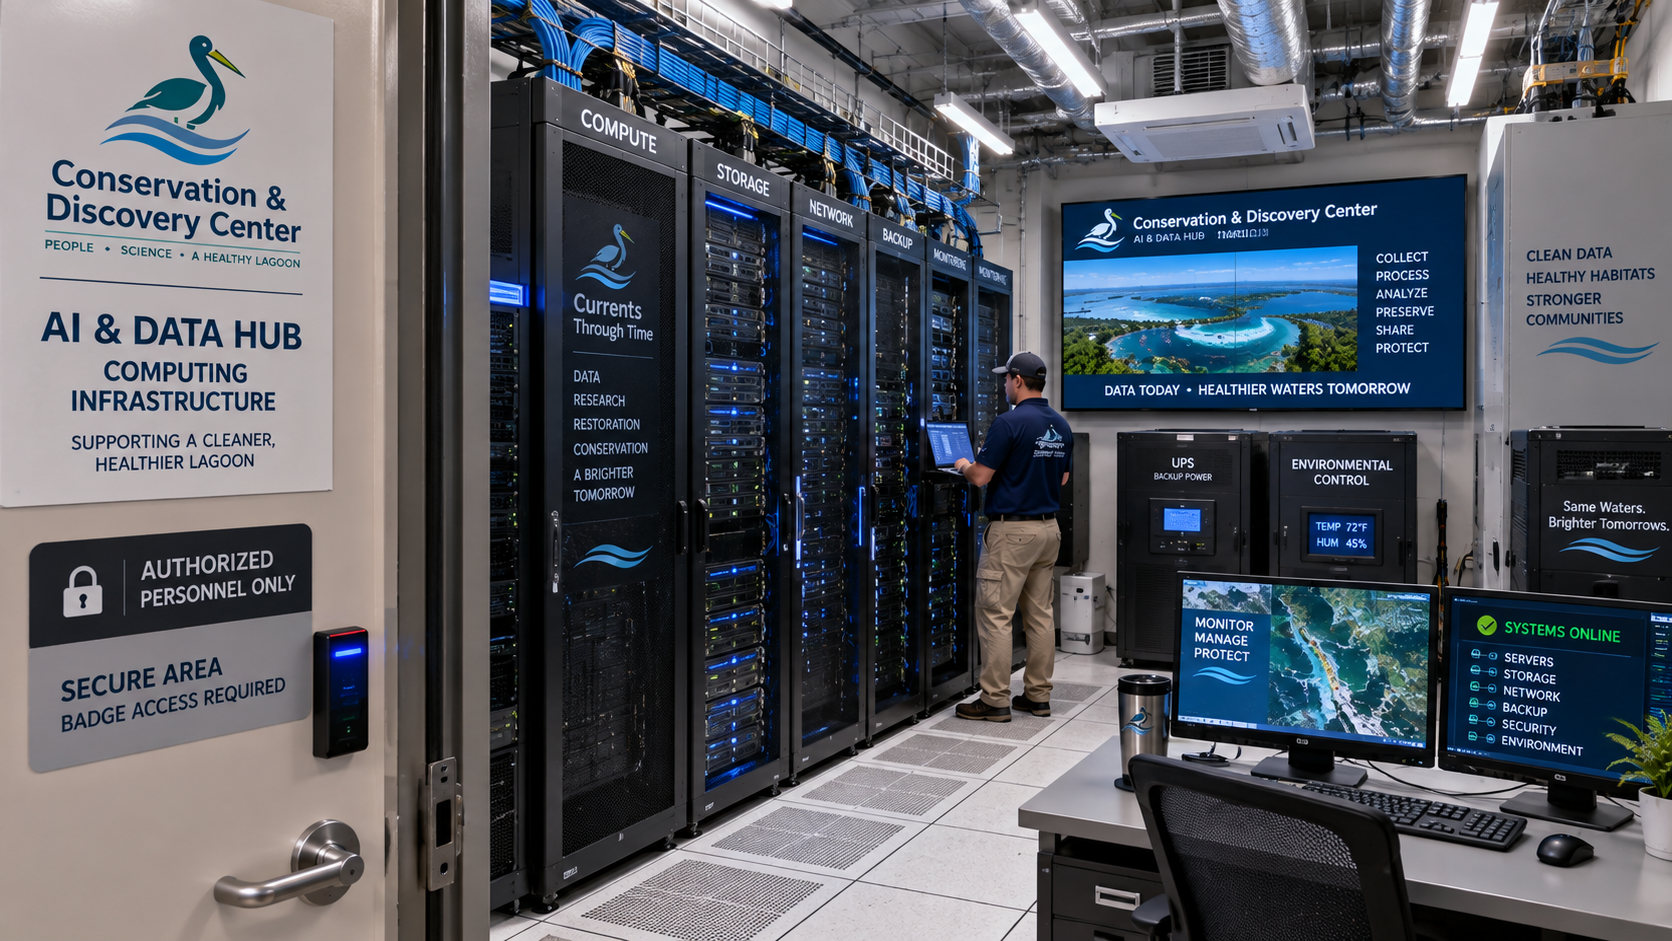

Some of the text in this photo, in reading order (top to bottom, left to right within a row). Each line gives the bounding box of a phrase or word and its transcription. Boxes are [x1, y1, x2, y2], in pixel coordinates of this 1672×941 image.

[580, 109, 657, 154] COMPUTE
[52, 159, 286, 211] Conservation &
[717, 163, 770, 197] STORAGE
[46, 193, 301, 243] Discovery Center
[809, 199, 853, 227] NETWORK
[1134, 204, 1377, 230] Conservation & Discovery Center
[883, 228, 913, 249] BACKUP
[1133, 234, 1143, 244] AI
[1156, 233, 1181, 242] DATA
[45, 240, 300, 268] PEOPLE SCIENCE A HEALTHY LAGOON
[1376, 251, 1428, 263] COLLECT
[1527, 247, 1612, 262] CLEAN DATA
[1377, 270, 1429, 281] PROCESS
[1527, 268, 1655, 284] HEALTHY HABITATS
[1376, 288, 1427, 299] ANALYZE
[1527, 293, 1601, 306] STRONGER
[574, 293, 641, 319] Currents
[1377, 306, 1434, 317] PRESERVE
[1527, 312, 1623, 326] COMMUNITIES
[41, 311, 301, 349] AI & DATA HUB
[574, 318, 653, 341] Through Time
[1376, 325, 1414, 335] SHARE
[1376, 342, 1429, 353] PROTECT
[104, 360, 247, 383] COMPUTING
[574, 370, 600, 383] DATA
[1105, 383, 1410, 395] DATA TODAY HEALTHIER WATERS TOMORROW
[72, 390, 275, 411] INFRASTRUCTURE
[574, 394, 625, 406] RESEARCH
[574, 418, 640, 430] RESTORATION
[72, 433, 275, 450] SUPPORTING A CLEANER,
[574, 443, 648, 455] CONSERVATION
[96, 454, 254, 472] HEALTHIER LAGOON
[1172, 458, 1194, 468] UPS
[1292, 459, 1393, 470] ENVIRONMENTAL
[574, 466, 633, 480] A BRIGHTER
[1185, 473, 1212, 481] POWER
[1314, 474, 1369, 485] CONTROL
[574, 486, 635, 501] TOMORROW
[1564, 501, 1645, 513] Same Waters.
[1316, 522, 1341, 530] TEMP
[1549, 516, 1669, 531] Brighter Tomorrows.
[1317, 538, 1338, 547] HUM
[141, 550, 274, 582] AUTHORIZED
[141, 574, 296, 608] PERSONNEL ONLY
[1196, 617, 1253, 632] MONITOR
[1505, 621, 1620, 642] SYSTEMS ONLINE
[1195, 632, 1248, 646] MANAGE
[1195, 648, 1250, 661] PROTECT
[1505, 653, 1553, 667] SERVERS
[61, 657, 222, 703] SECURE AREA
[1504, 669, 1556, 684] STORAGE
[1503, 686, 1560, 702] NETWORK
[62, 677, 285, 732] BADGE ACCESS REQUIRED
[1503, 703, 1547, 717] BACKUP
[1502, 719, 1556, 736] SECURITY
[1502, 736, 1583, 756] ENVIRONMENT
